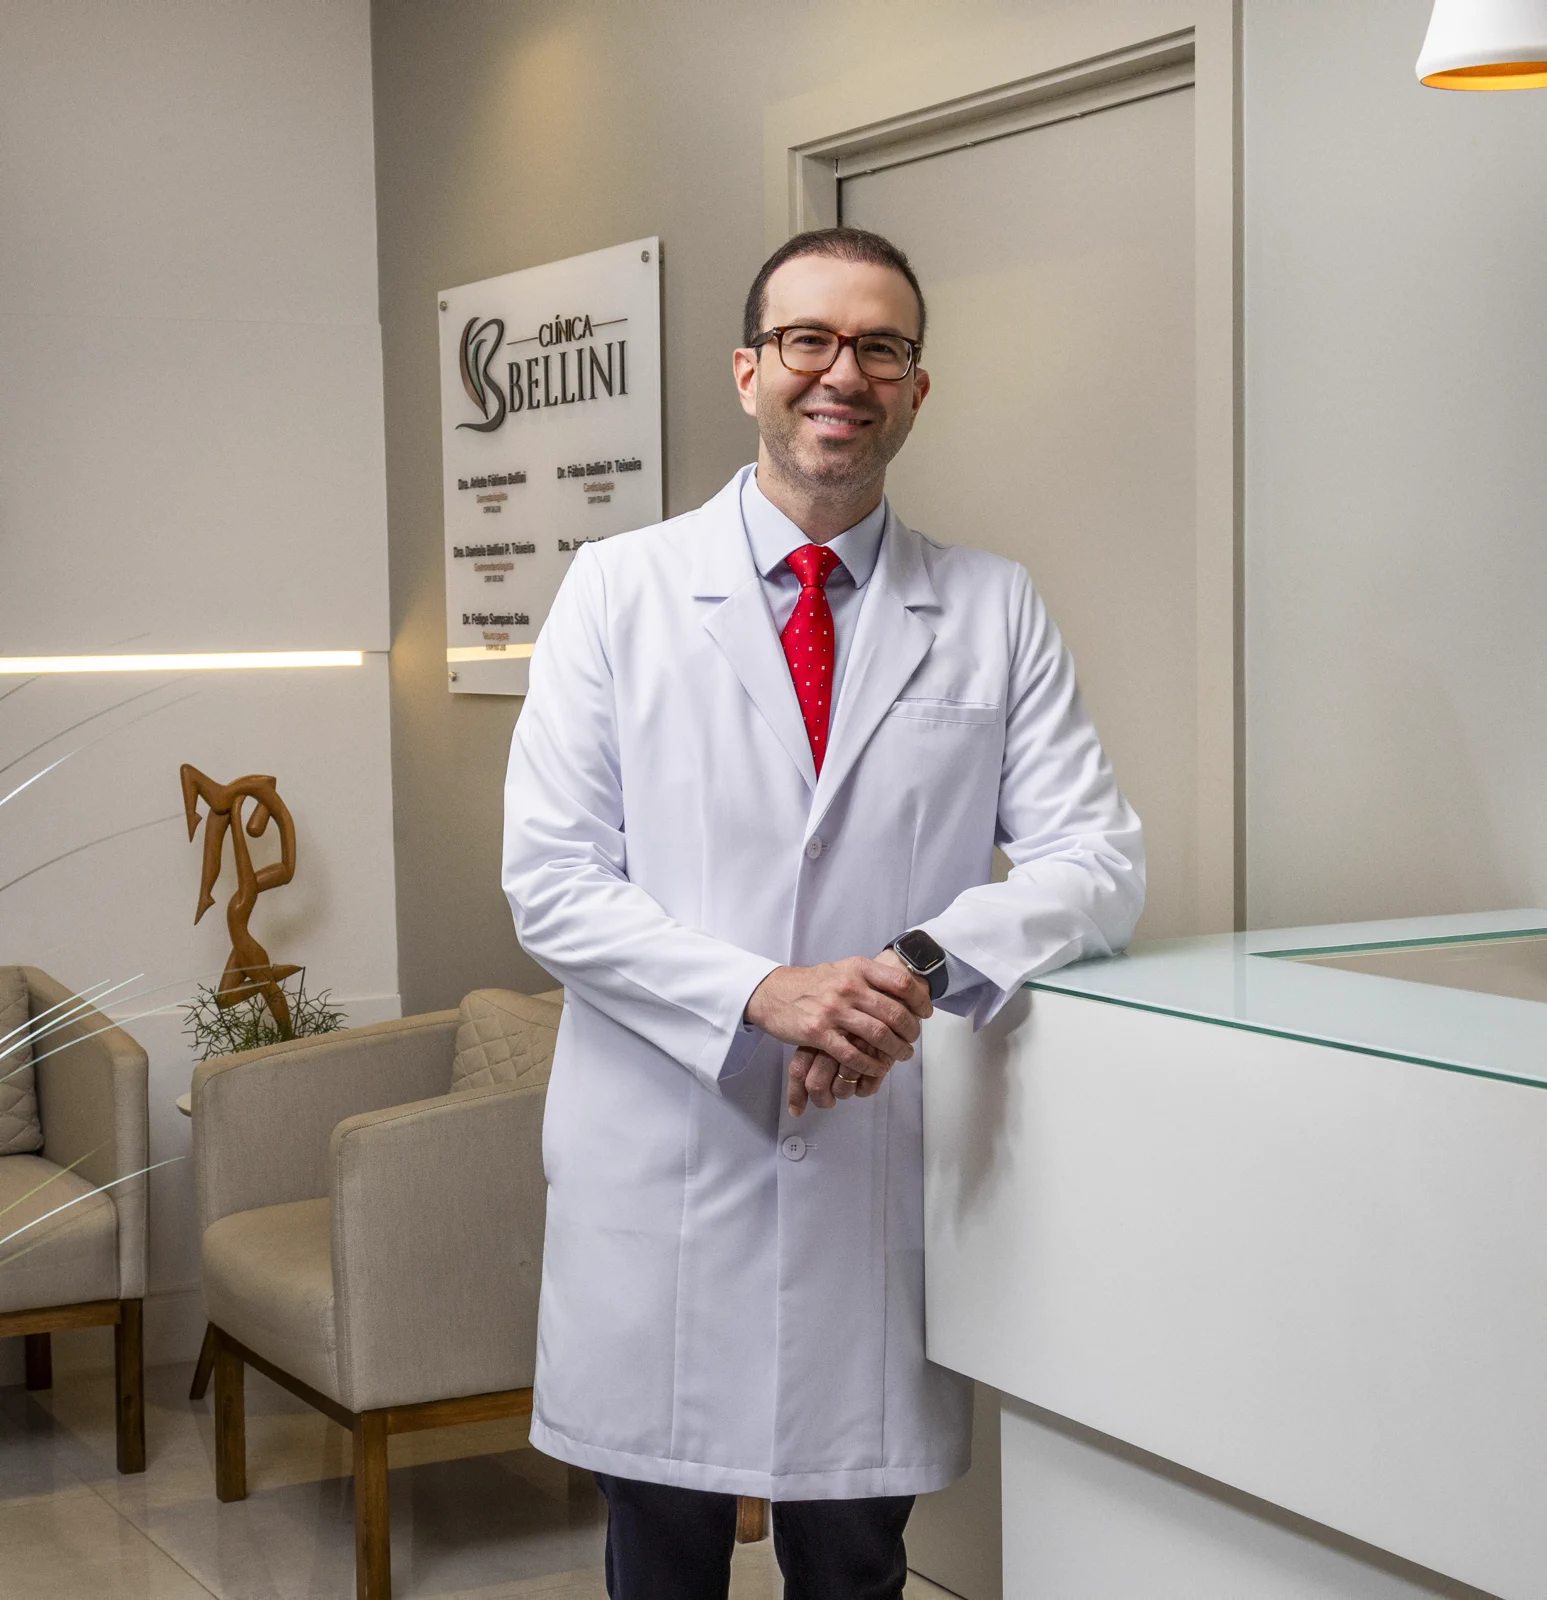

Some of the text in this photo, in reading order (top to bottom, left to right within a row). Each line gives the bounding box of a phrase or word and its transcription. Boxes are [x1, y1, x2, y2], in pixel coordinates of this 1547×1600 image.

[538, 314, 593, 348] CLÍNICA
[506, 340, 628, 413] BELLINI
[557, 466, 566, 479] Dr.
[614, 457, 642, 473] Teixeira
[511, 541, 535, 555] Teixeira
[462, 613, 471, 625] Dr.
